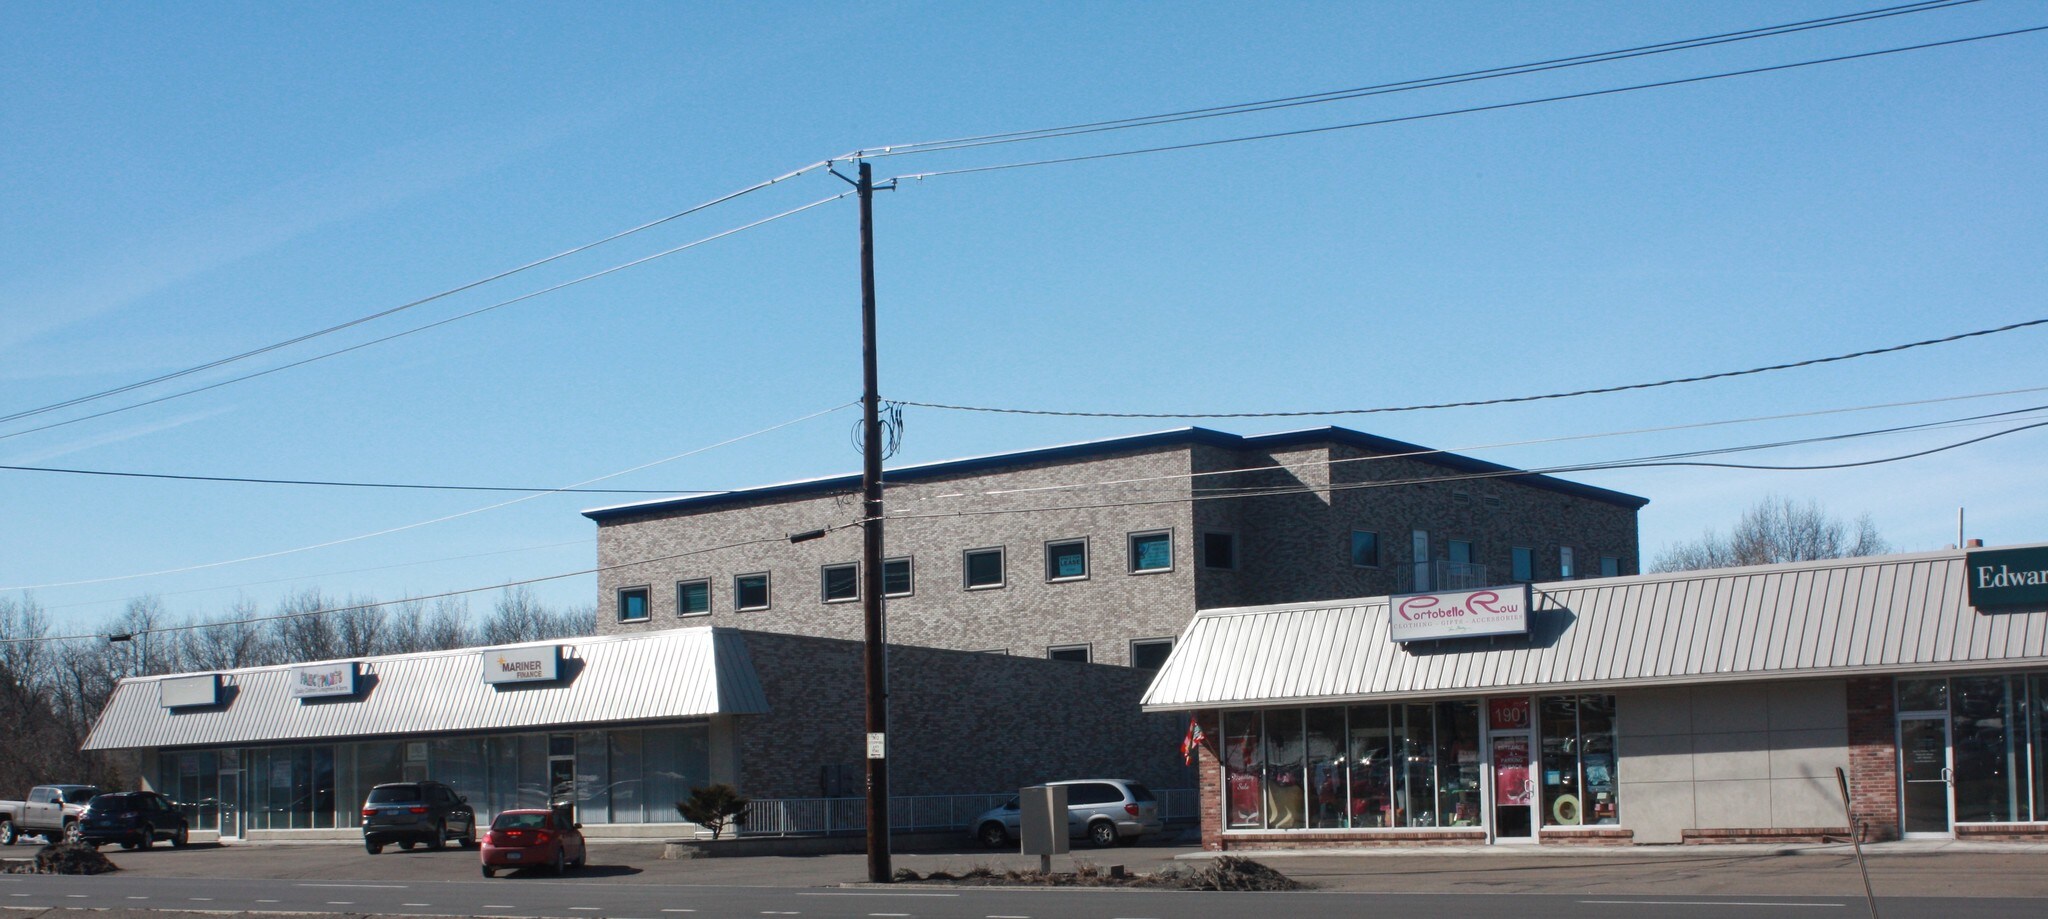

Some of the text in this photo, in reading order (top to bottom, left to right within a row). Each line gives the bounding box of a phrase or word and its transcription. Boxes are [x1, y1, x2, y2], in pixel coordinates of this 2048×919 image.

[1060, 558, 1080, 566] LEASE
[1399, 591, 1518, 621] Portobello Row
[1394, 614, 1522, 630] CLOTHING GIFTS ACCESSORIES
[502, 660, 541, 672] MARINER
[516, 671, 542, 679] FINANCE
[1496, 707, 1528, 722] 1901
[1237, 782, 1249, 791] Sale
